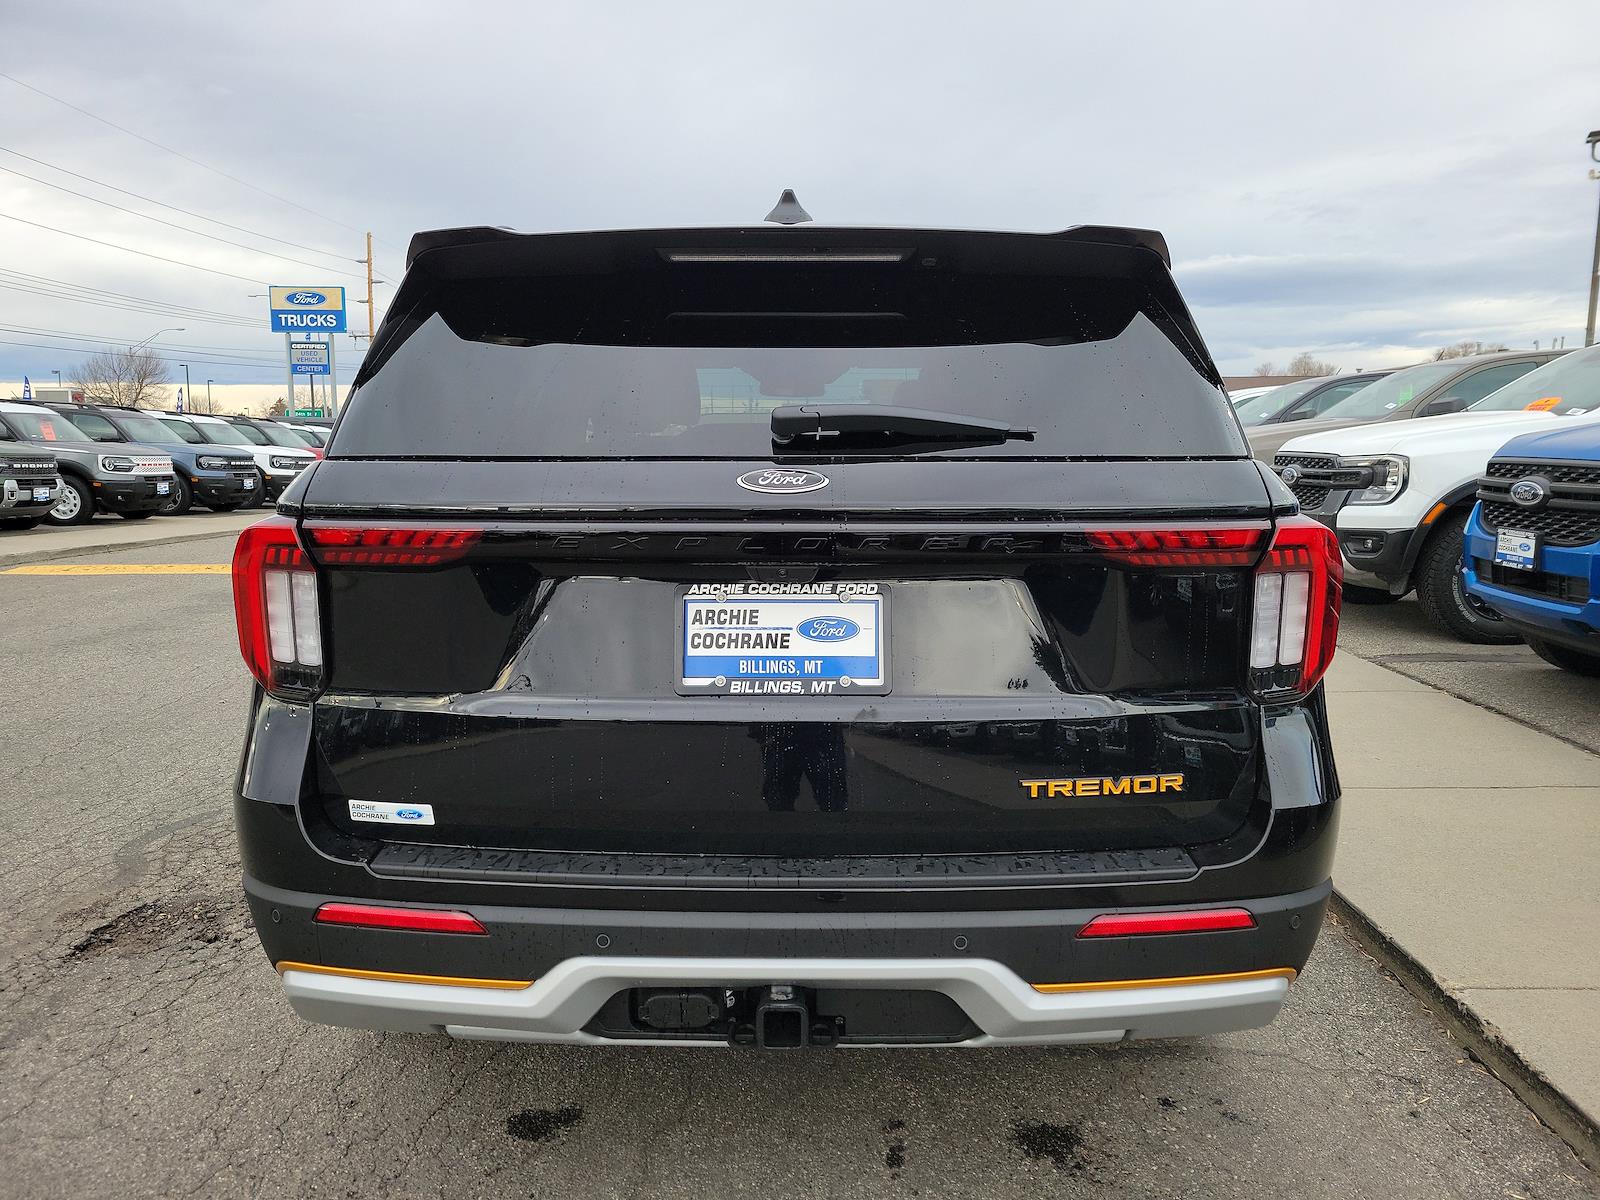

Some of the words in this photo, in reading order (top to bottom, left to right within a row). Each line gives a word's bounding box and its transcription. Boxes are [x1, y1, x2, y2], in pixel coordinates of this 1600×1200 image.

[294, 292, 319, 304] Ford
[279, 314, 337, 327] TRUCKS
[758, 471, 808, 485] Ford
[1515, 485, 1535, 500] Ford
[550, 534, 1016, 551] EXPLORER
[688, 584, 744, 595] ARCHIE
[748, 584, 832, 595] COCHRANE
[836, 584, 878, 595] FORD
[691, 609, 759, 625] ARCHIE
[809, 619, 846, 637] Ford
[690, 633, 790, 649] COCHRANE
[739, 660, 800, 676] BILLINGS,
[804, 661, 823, 674] MT
[729, 681, 805, 695] BILLINGS,
[808, 681, 836, 694] MT
[1019, 773, 1185, 798] TREMOR
[351, 803, 376, 811] ARCHIE
[400, 809, 420, 819] Ford
[352, 811, 390, 820] COCHRANE
